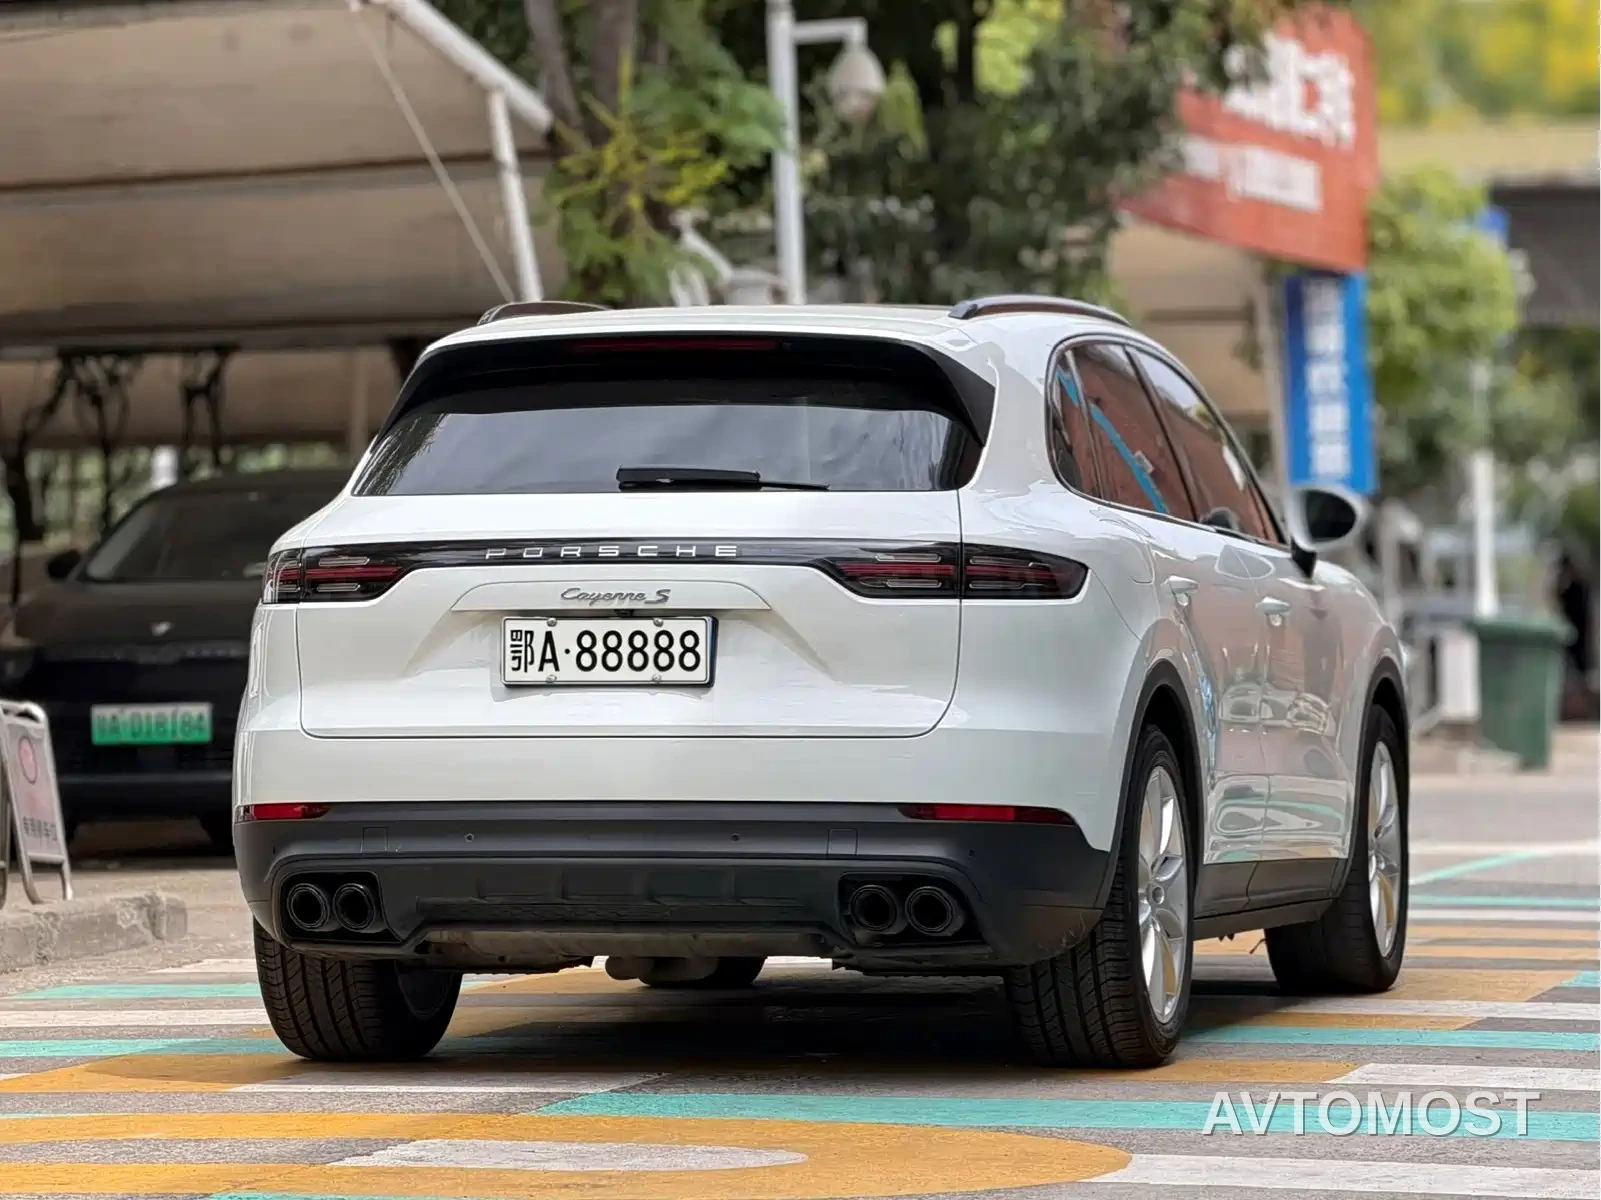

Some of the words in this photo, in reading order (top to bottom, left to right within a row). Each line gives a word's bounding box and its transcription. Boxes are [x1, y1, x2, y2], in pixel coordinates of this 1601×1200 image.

[486, 545, 737, 559] PORSCHE
[560, 587, 645, 606] Cayenne
[645, 588, 671, 604] S
